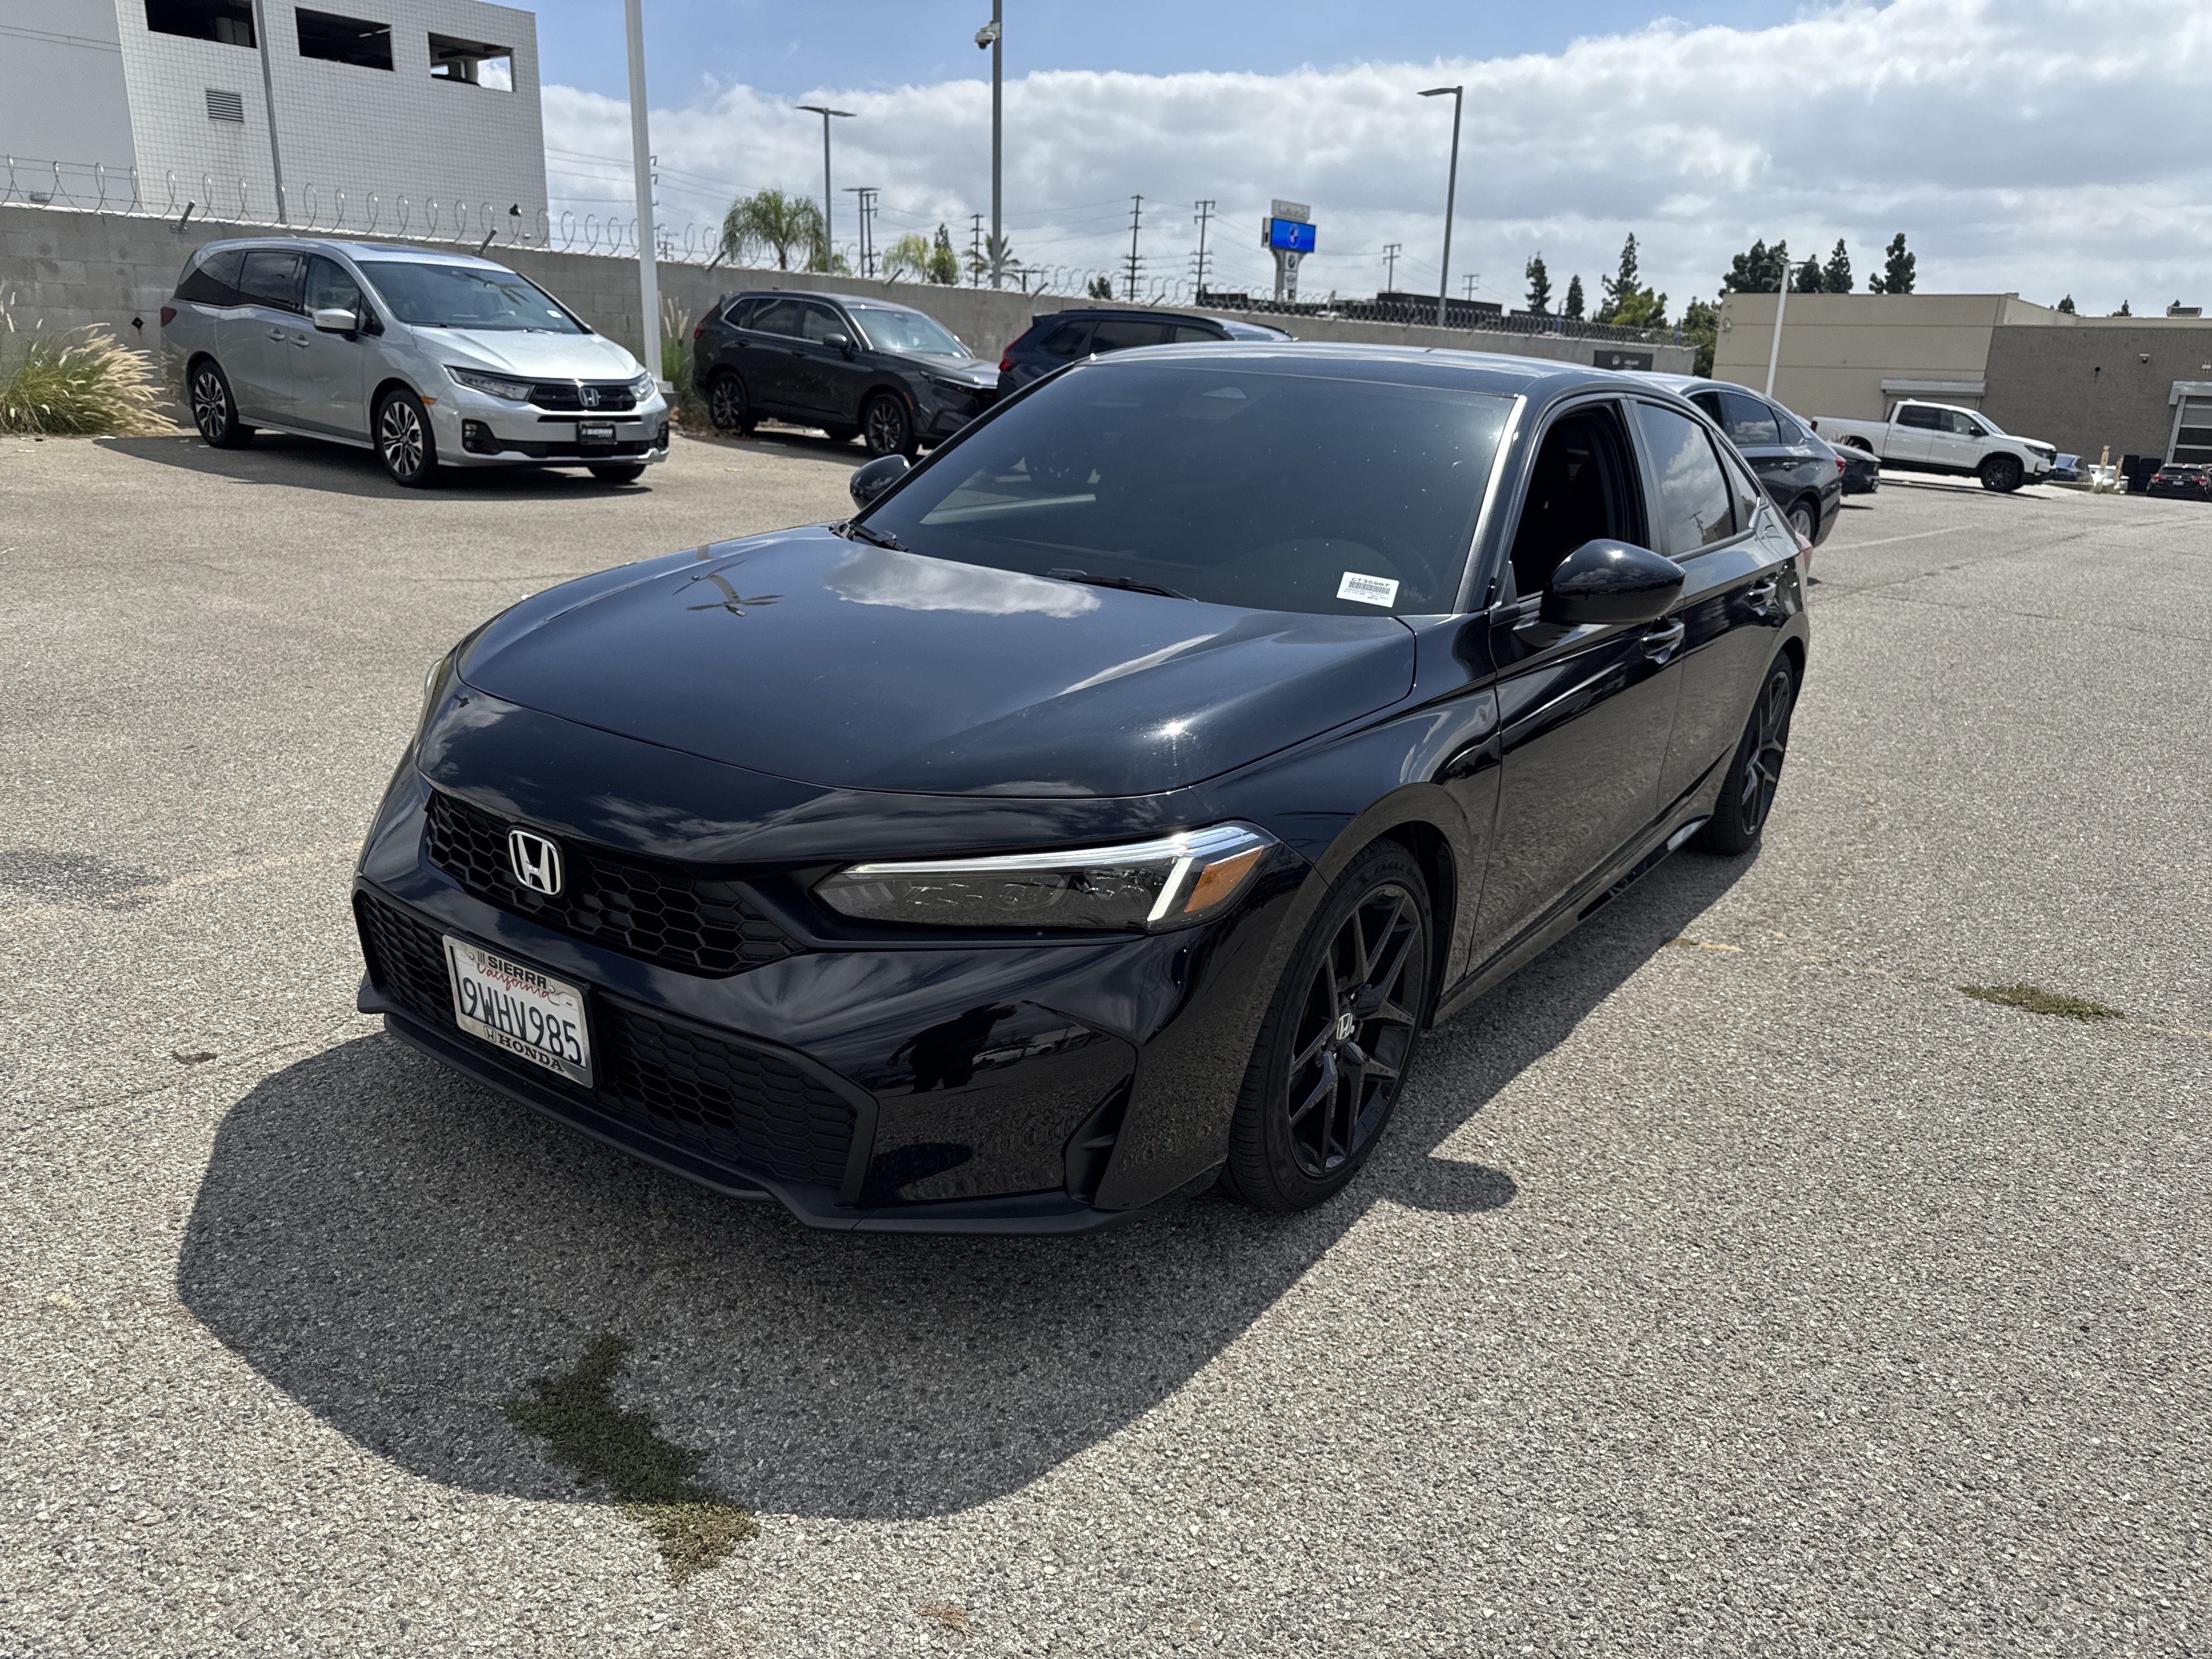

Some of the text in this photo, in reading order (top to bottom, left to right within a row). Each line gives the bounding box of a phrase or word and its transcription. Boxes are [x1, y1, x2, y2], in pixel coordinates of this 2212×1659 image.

[1374, 862, 1406, 874] EAGLE
[488, 955, 547, 989] SIERRA
[462, 977, 582, 1066] 9WHV985
[498, 1034, 565, 1073] HONDA
